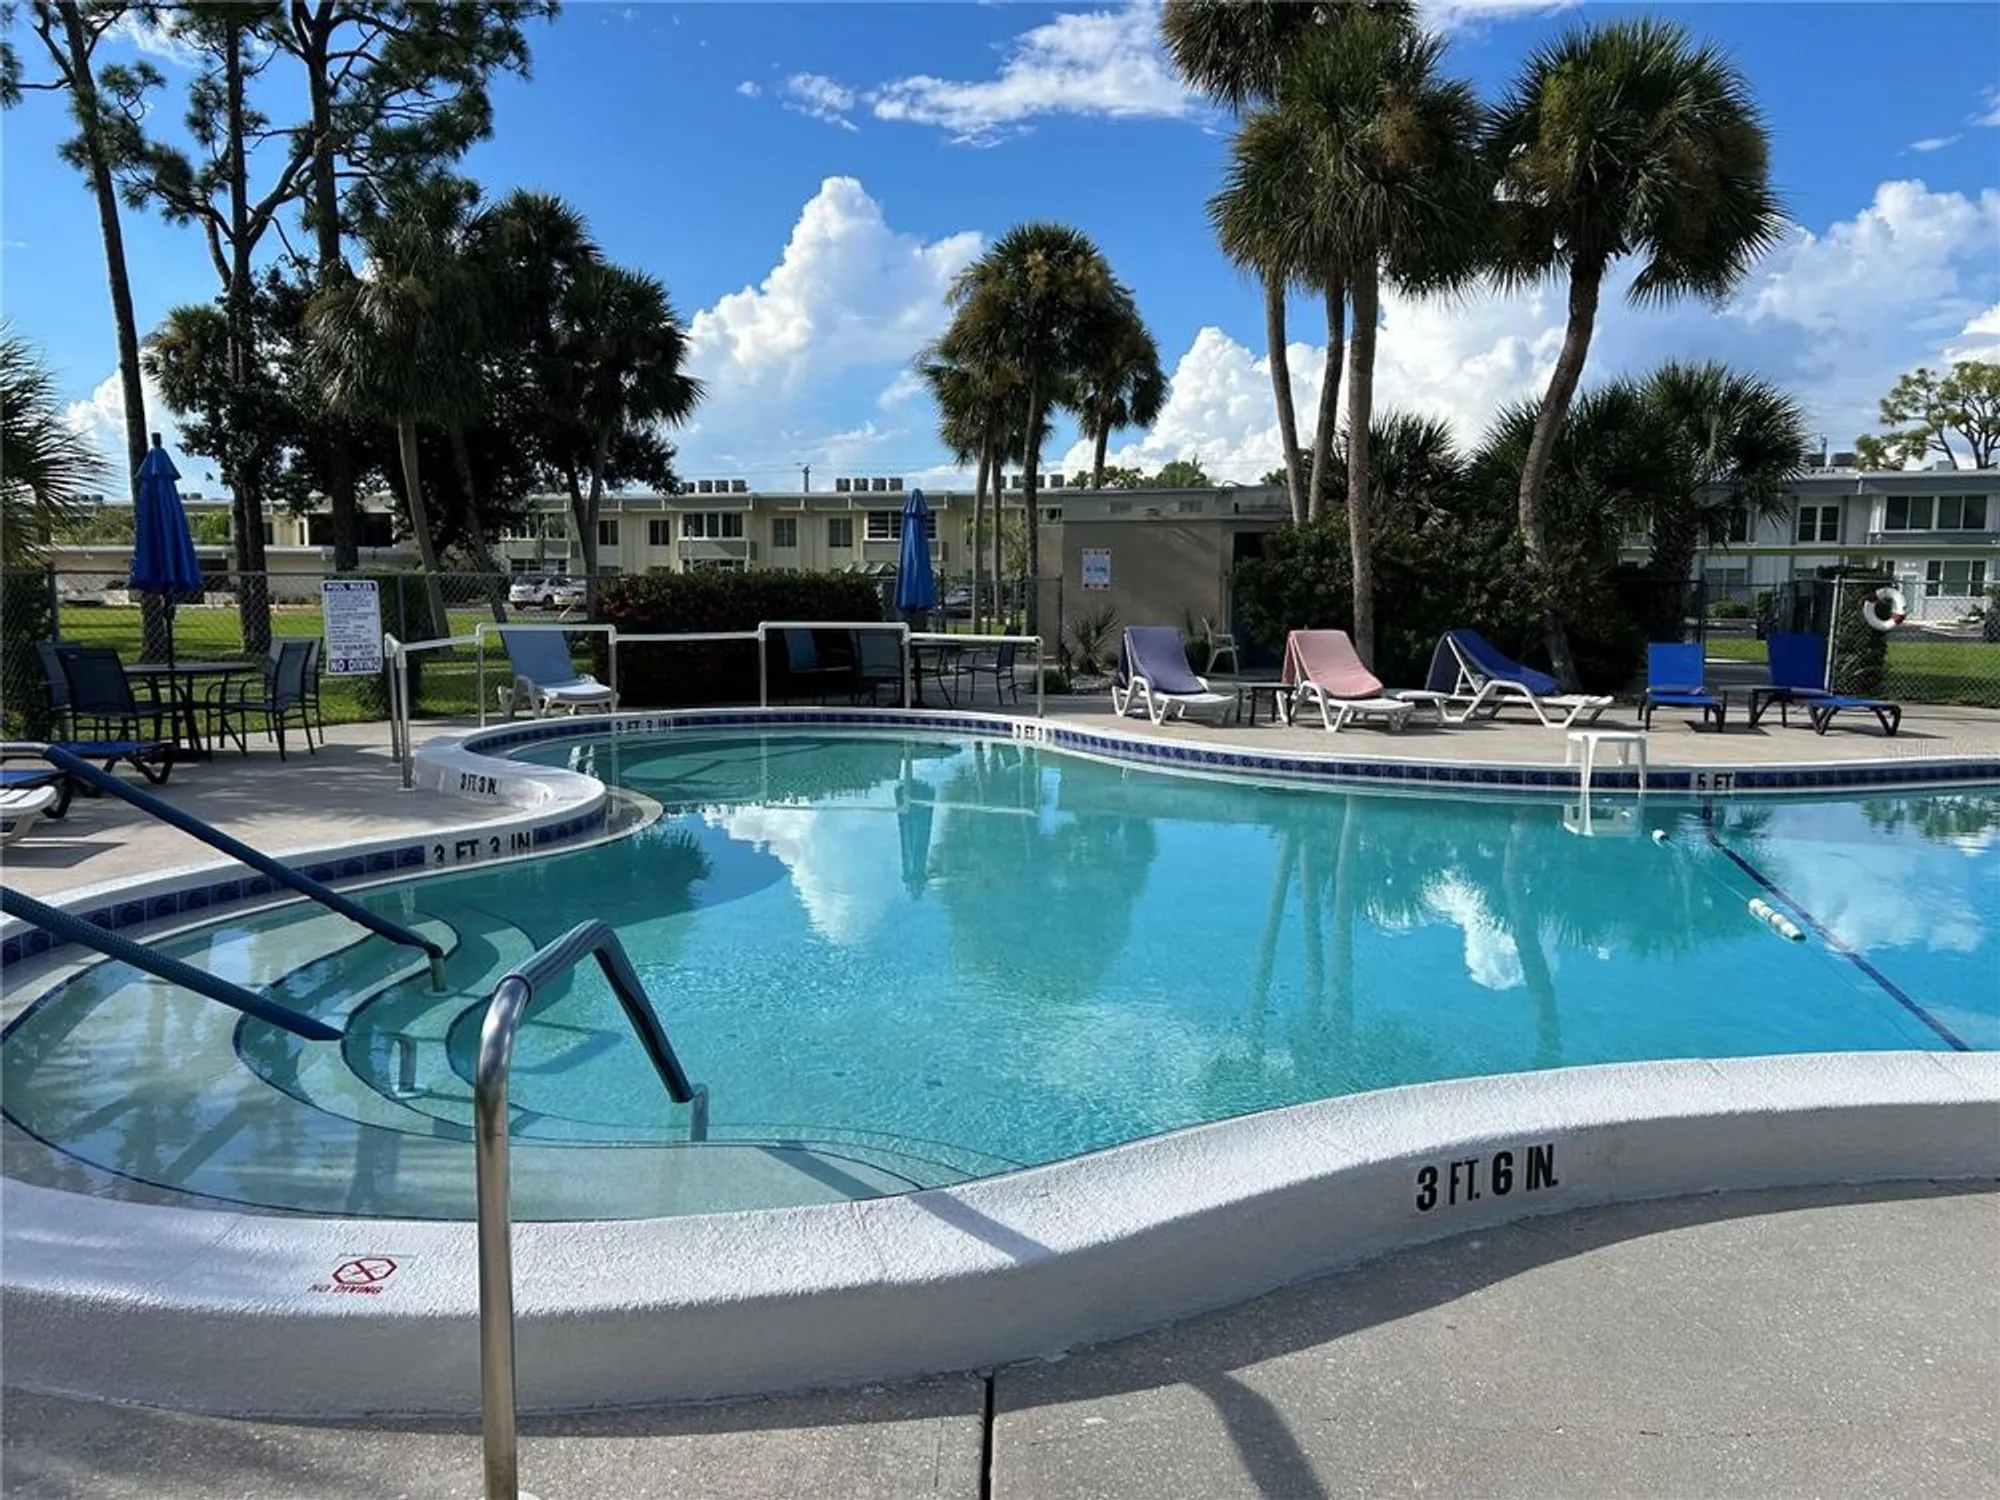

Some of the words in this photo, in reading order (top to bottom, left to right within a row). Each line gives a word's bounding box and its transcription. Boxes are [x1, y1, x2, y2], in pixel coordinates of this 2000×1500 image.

[330, 659, 345, 672] NO
[1714, 773, 1733, 789] FT
[456, 840, 479, 859] FT
[511, 832, 530, 850] IN
[1416, 1165, 1438, 1211] 3
[1449, 1158, 1481, 1205] FT.
[1492, 1151, 1513, 1195] 6
[1526, 1144, 1558, 1190] IN.
[306, 1283, 331, 1294] NO
[332, 1284, 384, 1295] DIVING
